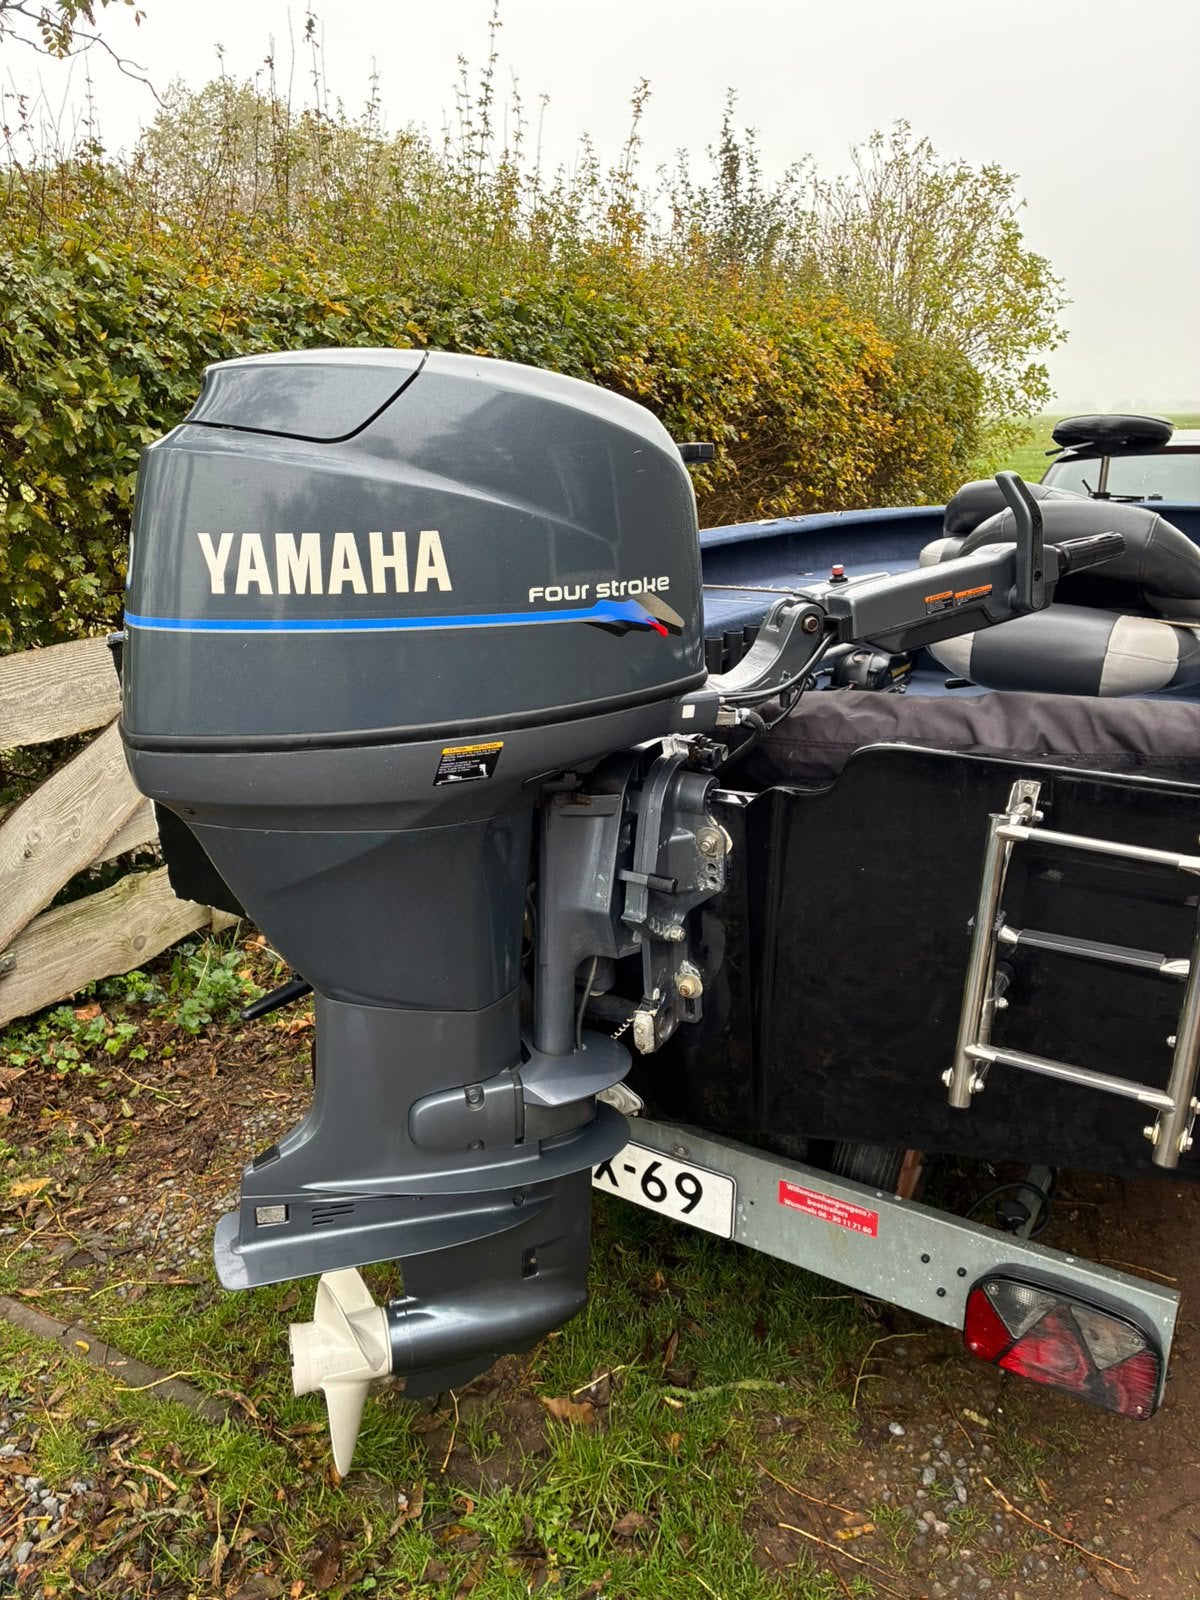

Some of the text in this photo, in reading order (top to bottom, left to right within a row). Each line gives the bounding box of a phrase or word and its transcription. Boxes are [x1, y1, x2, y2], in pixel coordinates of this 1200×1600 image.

[197, 530, 453, 595] YAMAHA
[817, 1210, 827, 1218] 06
[832, 1215, 842, 1224] 30
[842, 1219, 852, 1228] 11
[852, 1221, 862, 1231] 71
